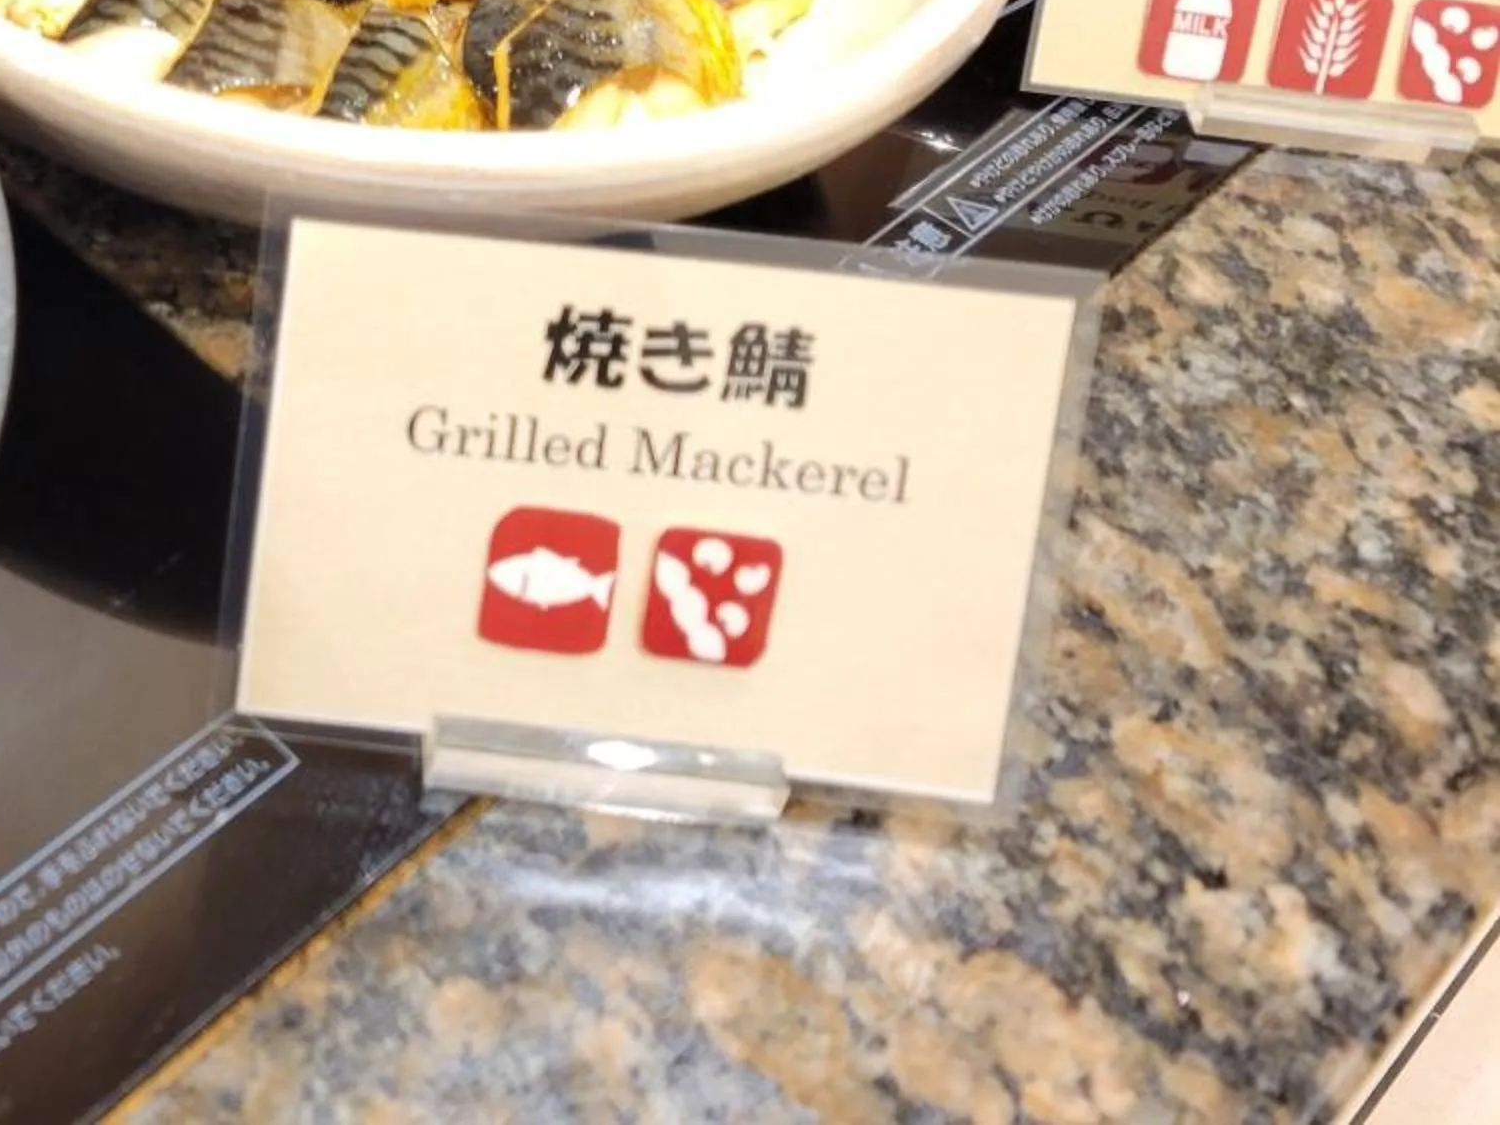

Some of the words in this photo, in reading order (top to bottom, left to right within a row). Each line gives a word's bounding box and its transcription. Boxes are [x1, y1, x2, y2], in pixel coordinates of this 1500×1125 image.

[542, 304, 817, 411] 焼き鯖
[405, 405, 608, 472] Grilled
[628, 426, 914, 505] Mackerel
